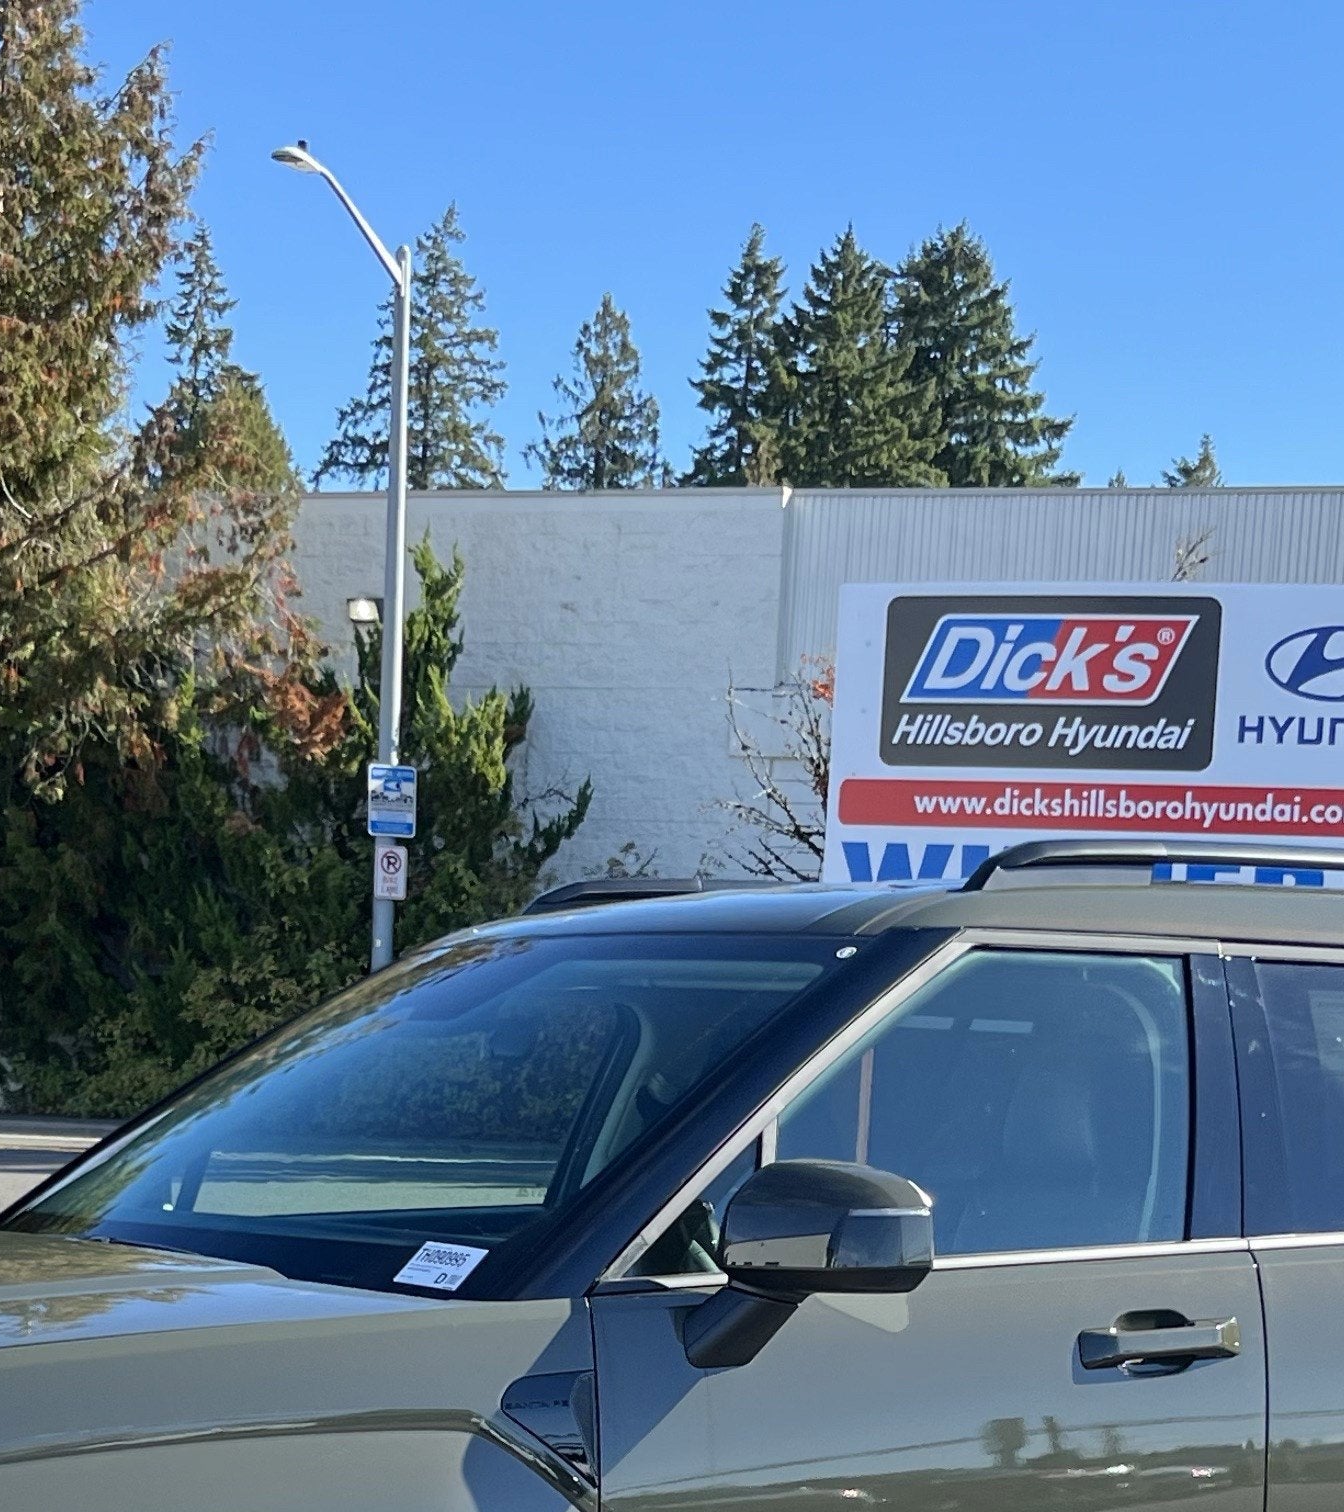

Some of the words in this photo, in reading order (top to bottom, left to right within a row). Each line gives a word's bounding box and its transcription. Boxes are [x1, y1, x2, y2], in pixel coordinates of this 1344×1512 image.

[923, 624, 1159, 693] Dick's
[892, 714, 1043, 745] Hillsboro
[1047, 716, 1195, 755] Hyundai
